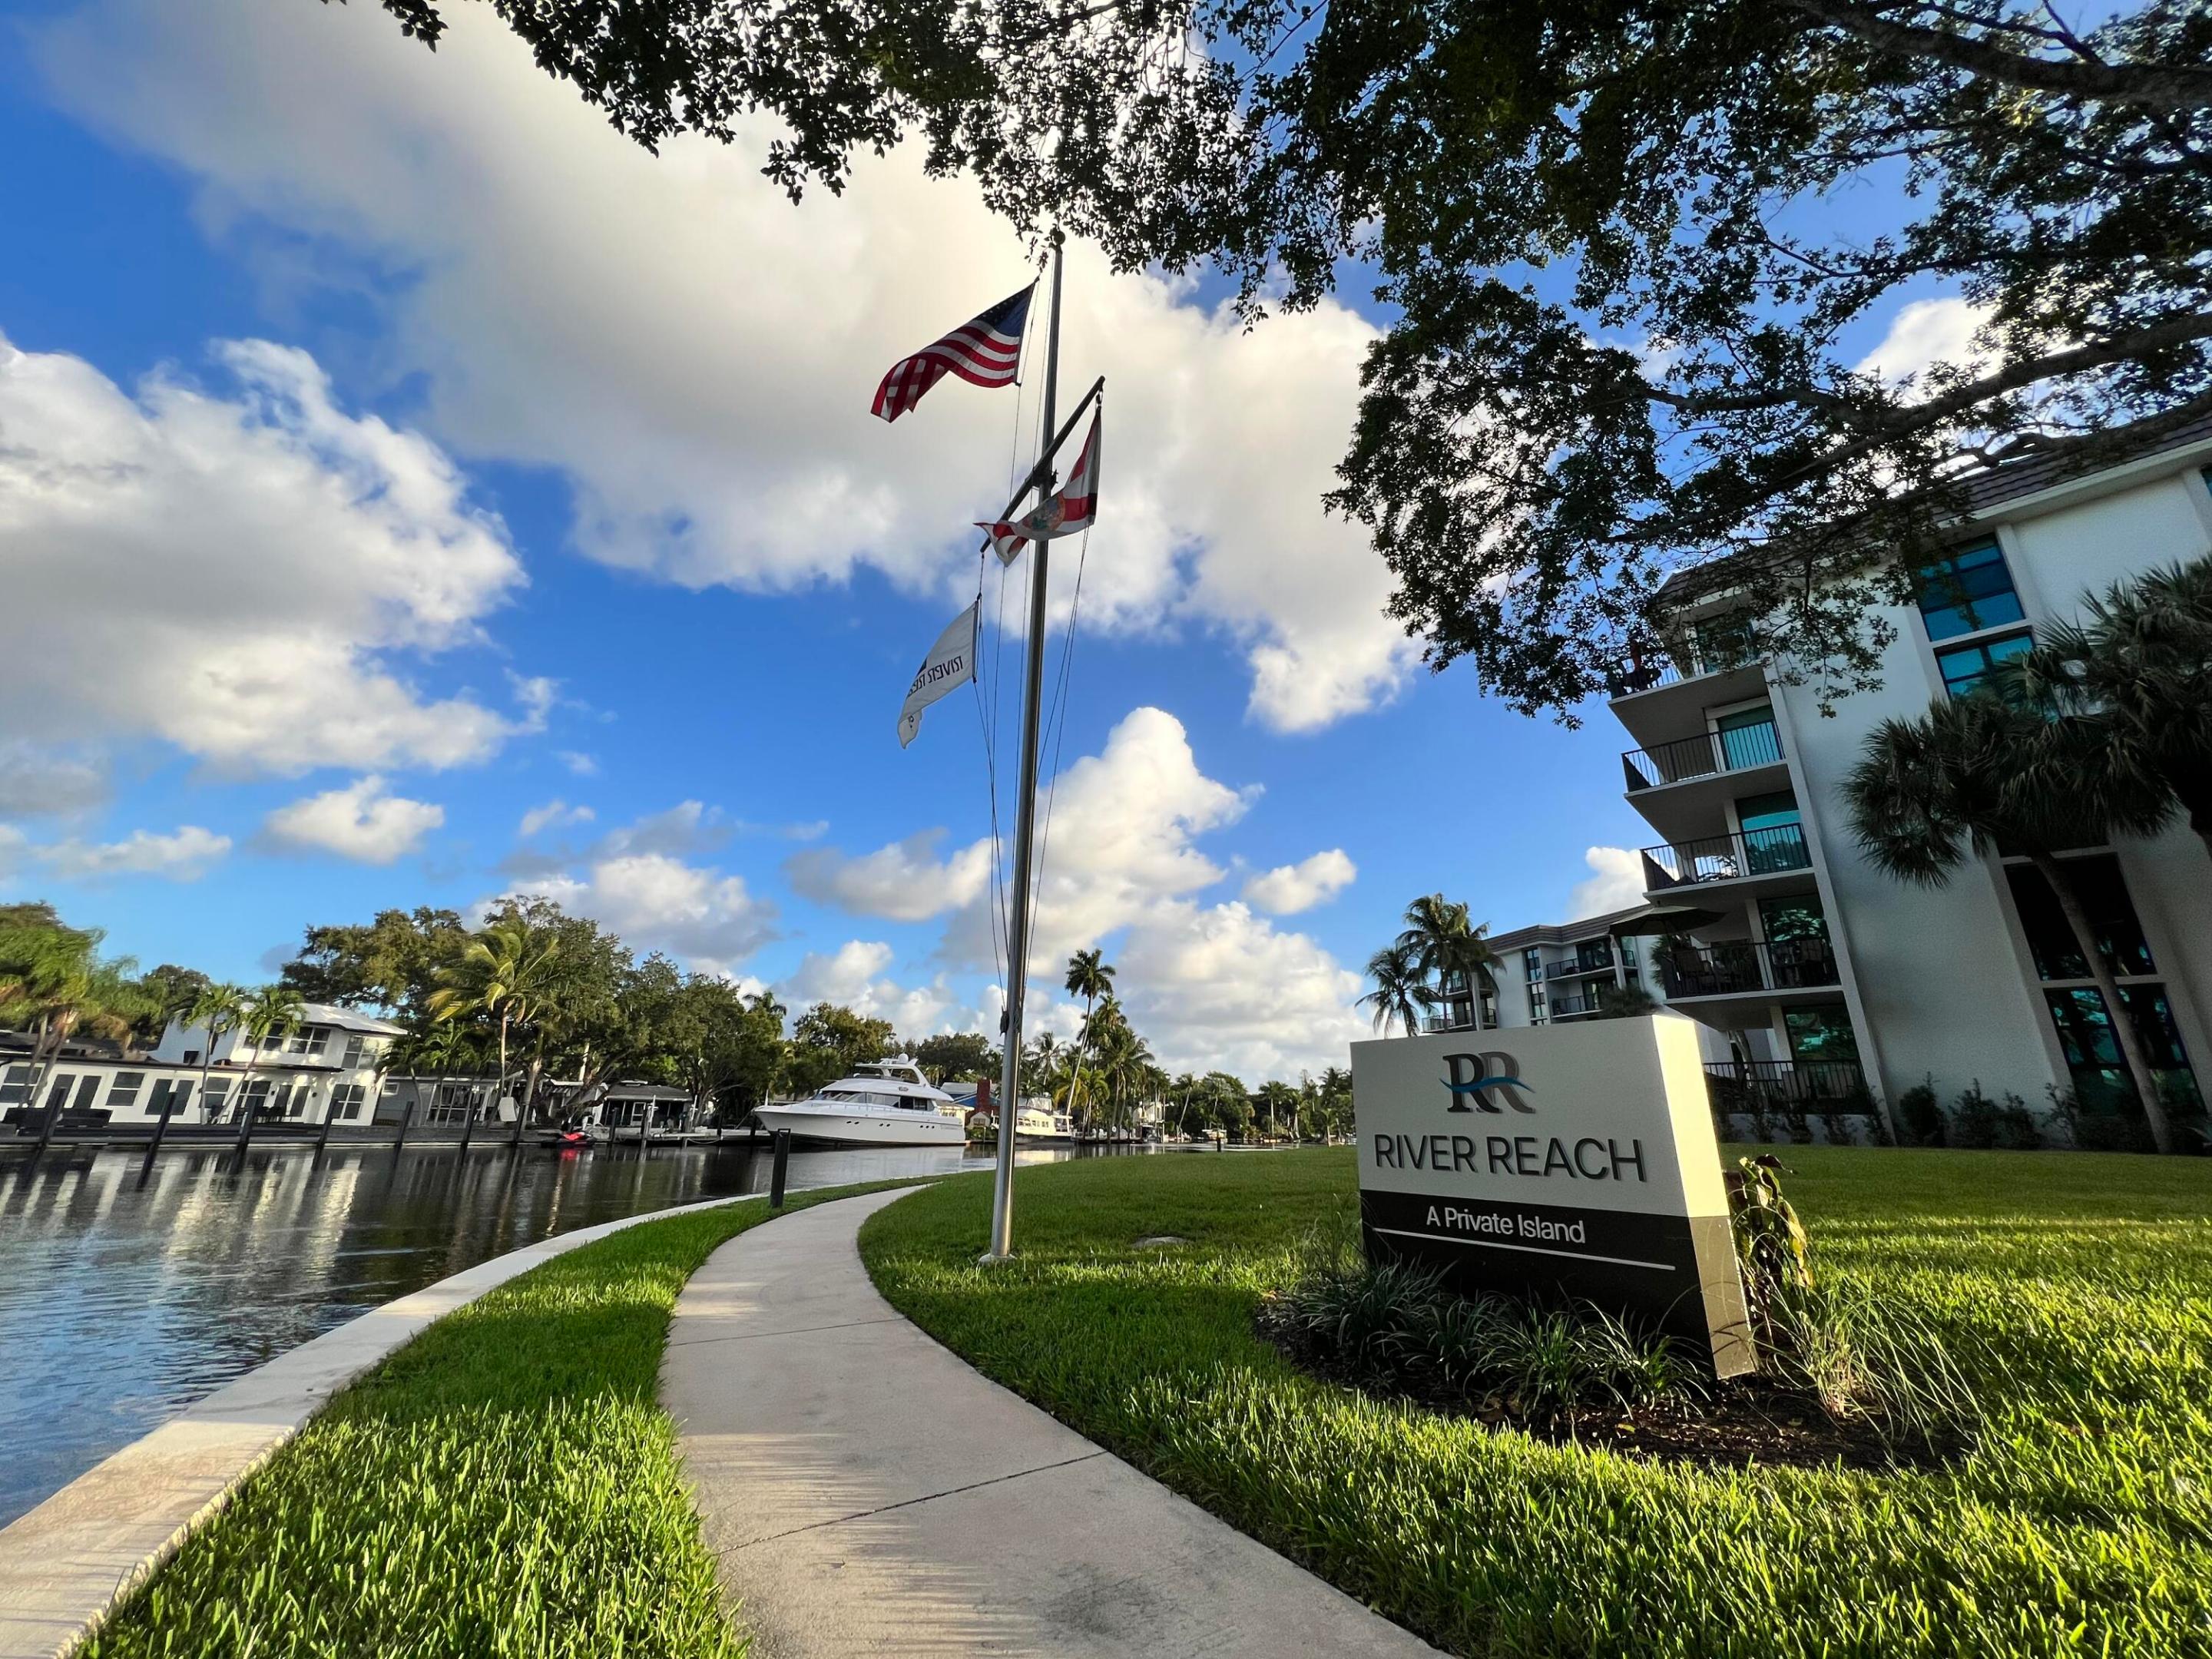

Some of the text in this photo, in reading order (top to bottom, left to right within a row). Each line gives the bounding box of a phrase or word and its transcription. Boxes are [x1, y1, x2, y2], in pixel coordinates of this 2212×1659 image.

[1374, 1134, 1647, 1183] RIVER REACH
[1426, 1206, 1586, 1244] A Private Island
